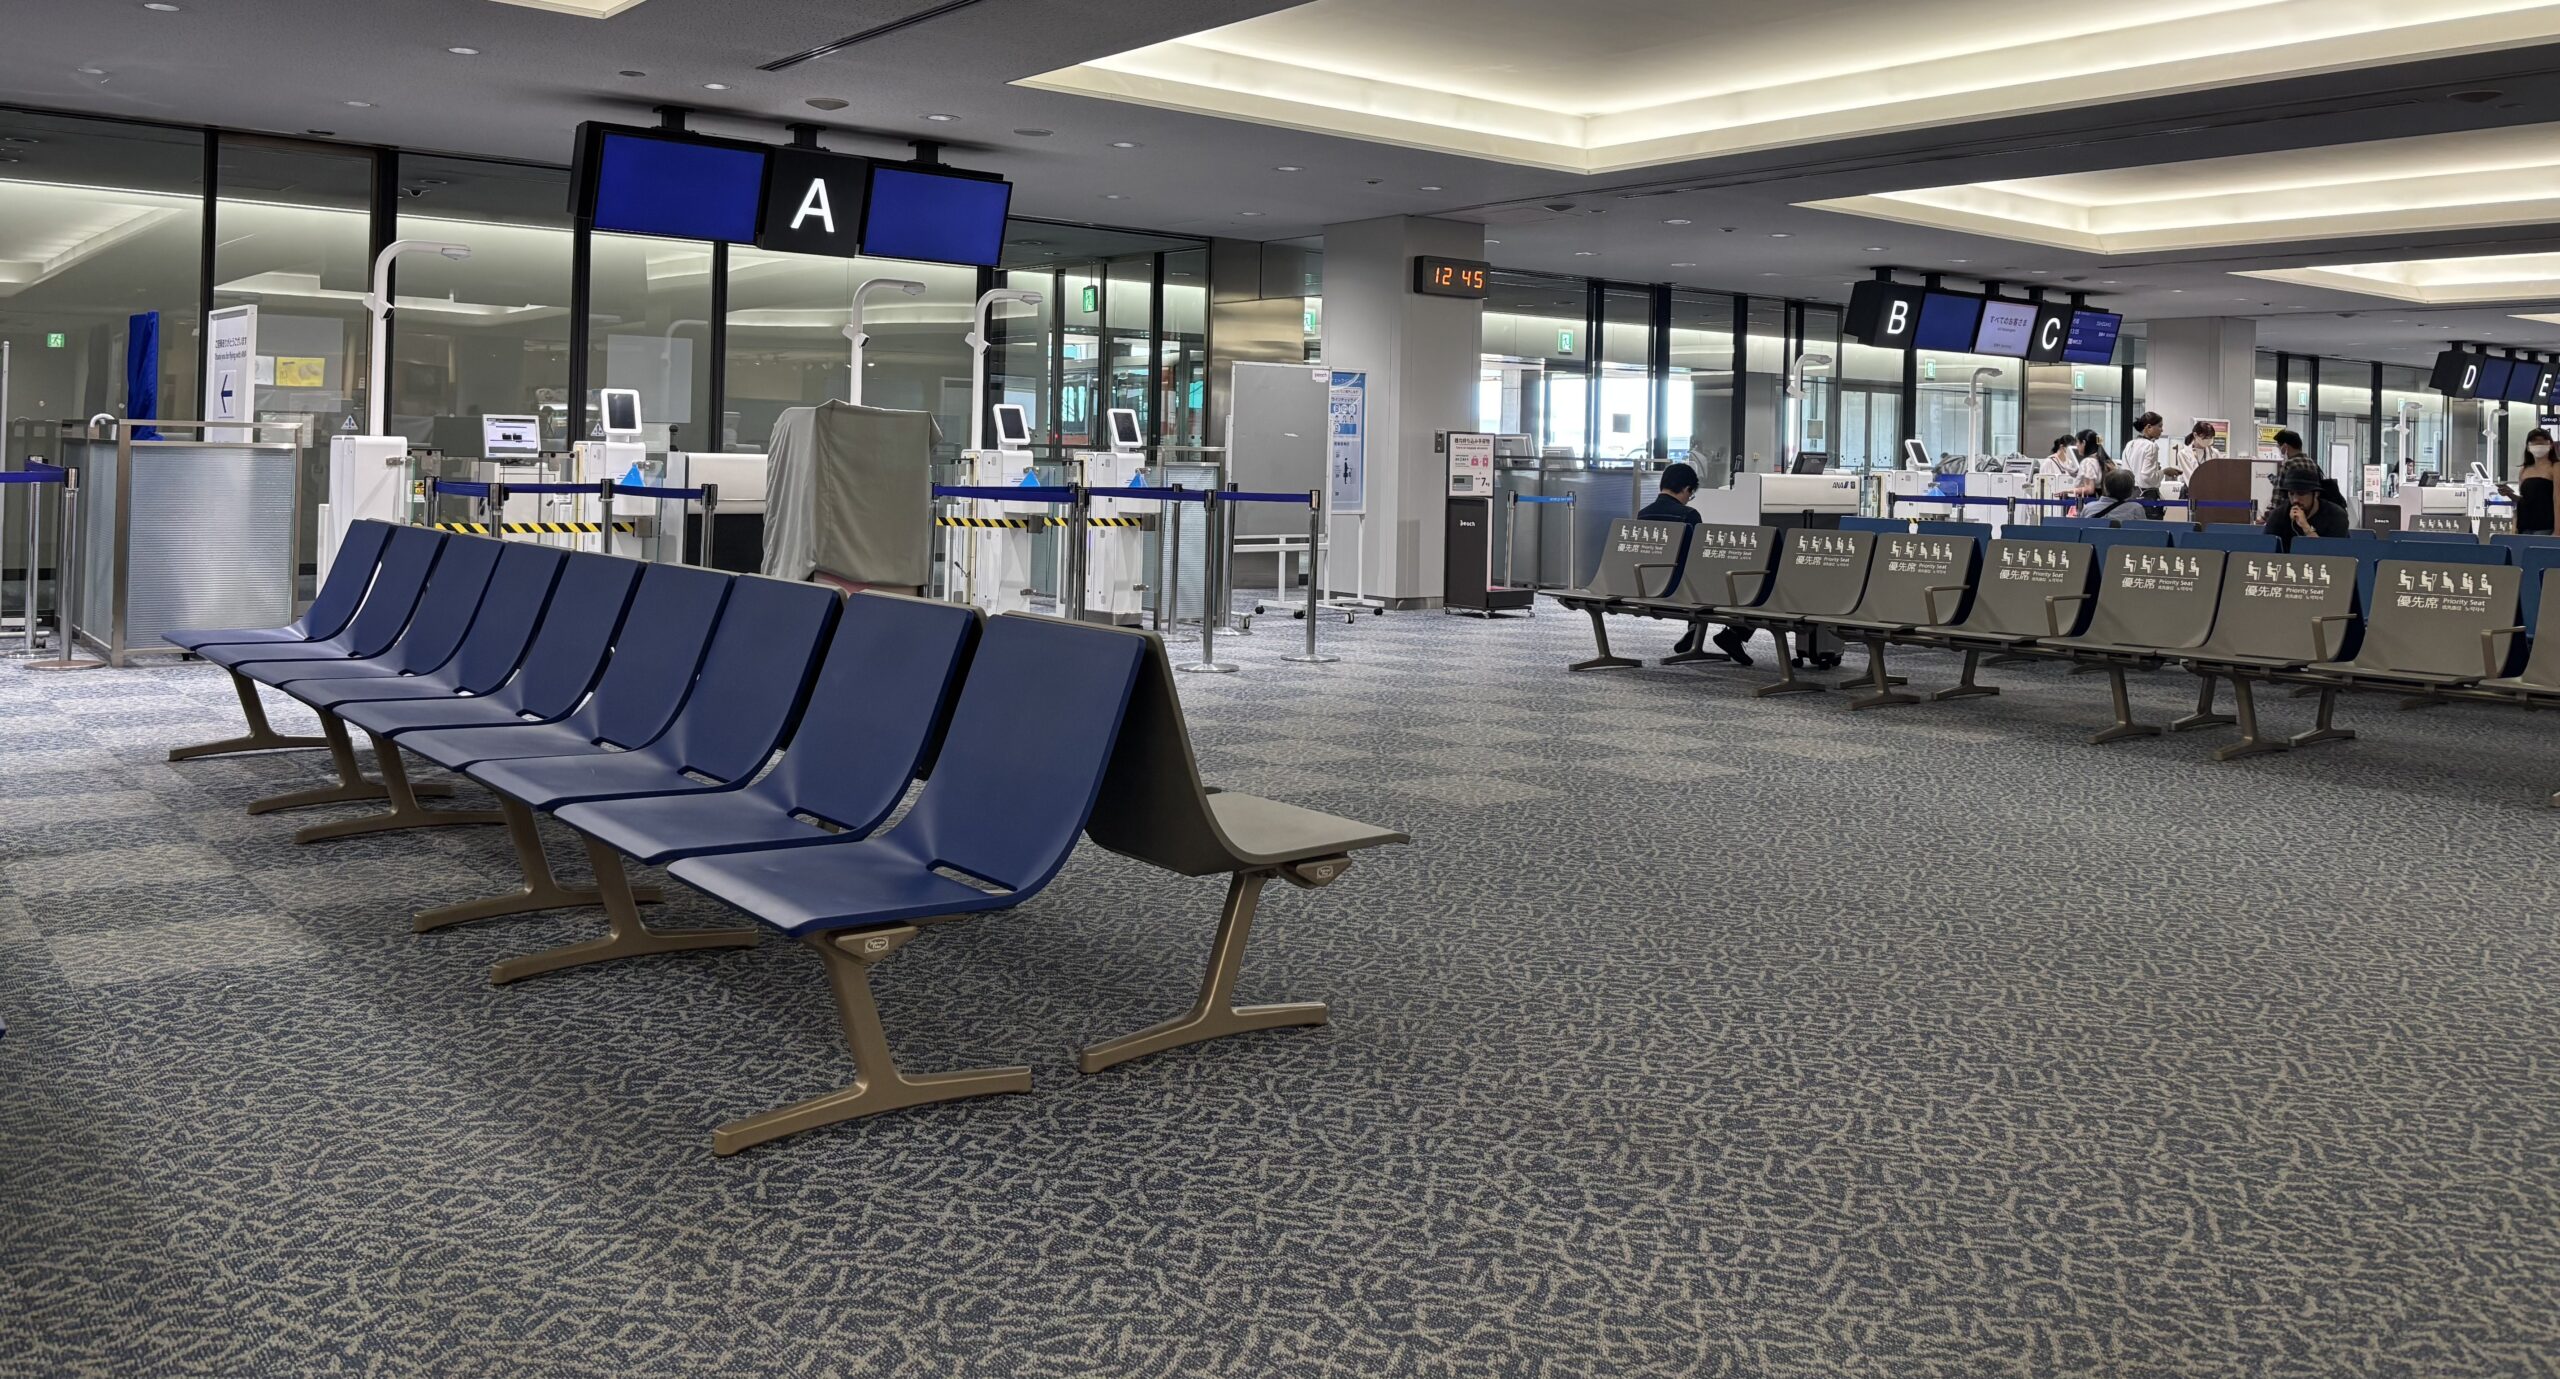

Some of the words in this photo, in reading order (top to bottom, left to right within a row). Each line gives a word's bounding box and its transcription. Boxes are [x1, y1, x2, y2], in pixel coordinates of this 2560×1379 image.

[790, 178, 835, 233] A
[1435, 266, 1453, 286] 12
[1461, 269, 1484, 289] 45
[1887, 300, 1909, 335] B
[2042, 317, 2061, 350] C
[2462, 365, 2477, 389] D
[2538, 373, 2552, 397] E
[1481, 477, 1487, 487] 7
[1888, 561, 1917, 572] 優先席
[1999, 569, 2031, 581] 優先席
[2121, 576, 2156, 589] 優先席
[2244, 584, 2283, 598] 優先席
[2397, 595, 2440, 609] 優先席
[2442, 597, 2468, 606] Priority
